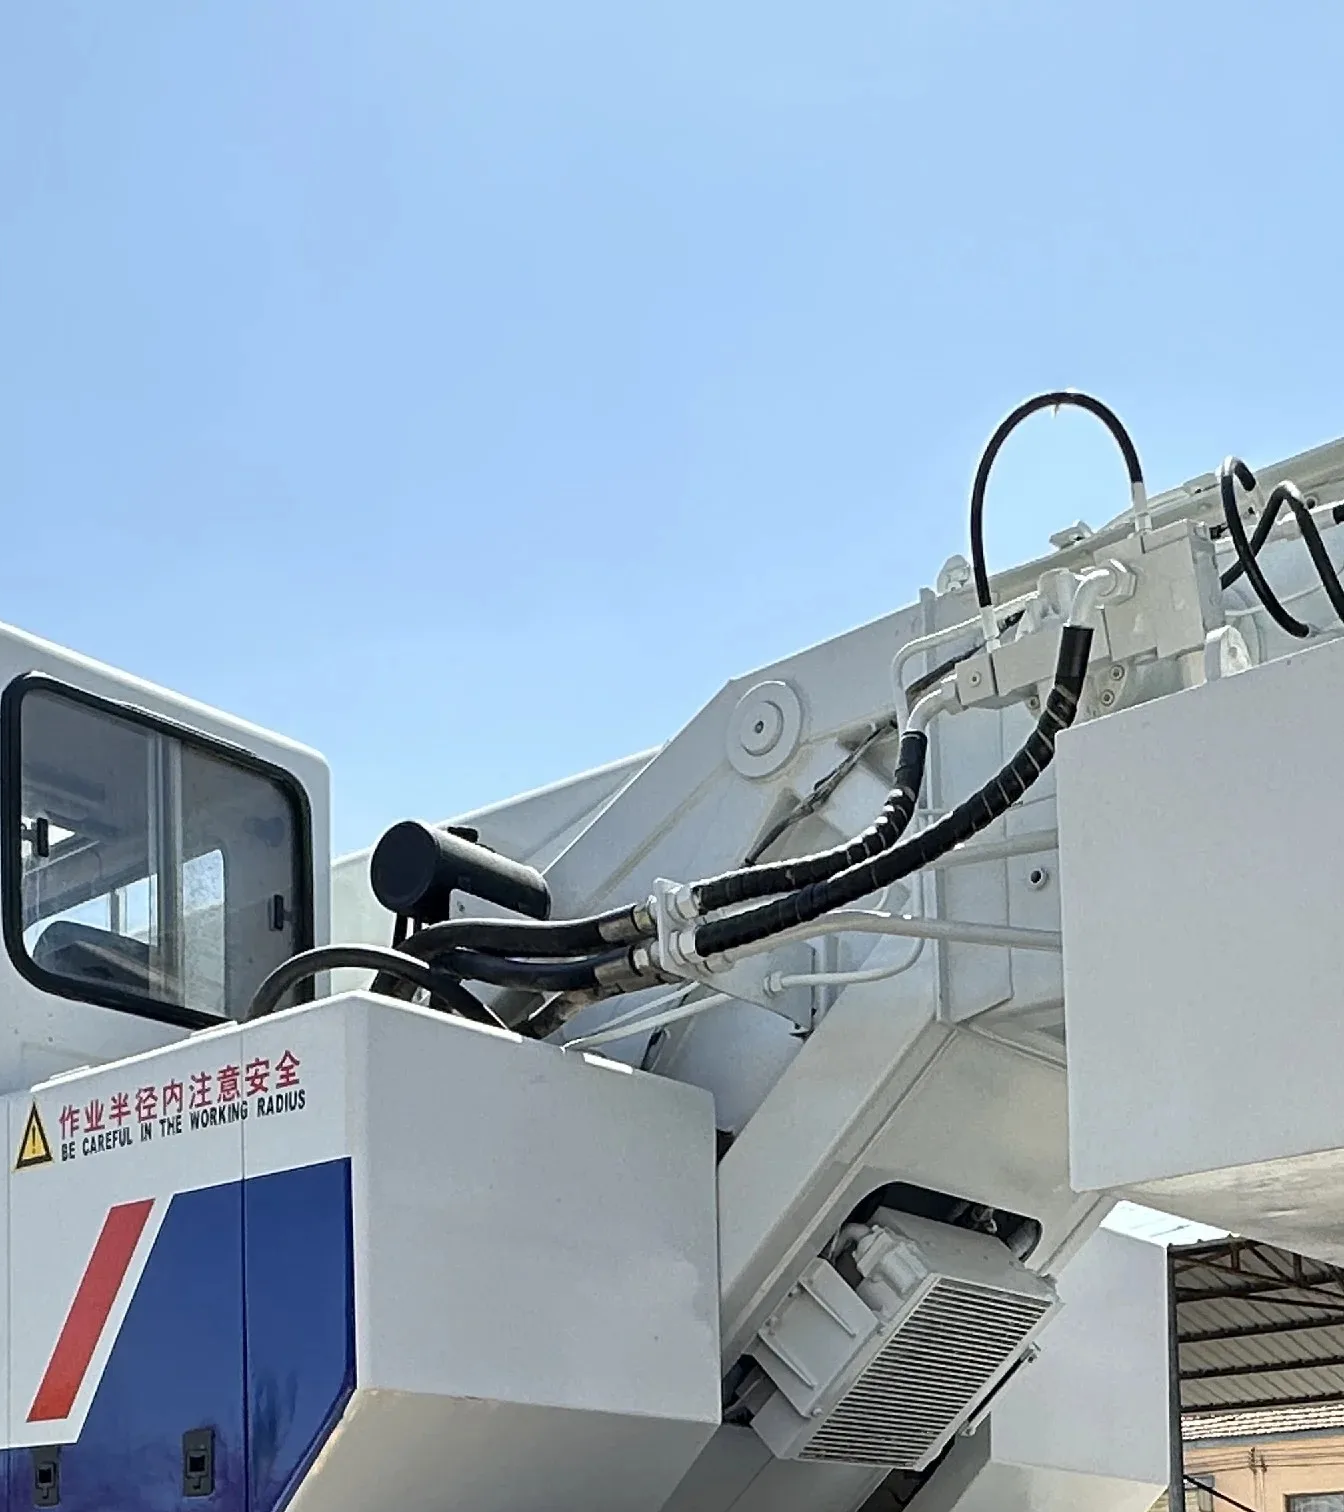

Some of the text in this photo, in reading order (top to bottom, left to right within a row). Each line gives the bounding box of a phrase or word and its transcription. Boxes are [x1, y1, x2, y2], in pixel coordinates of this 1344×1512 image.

[59, 1049, 301, 1140] 作业半径内注意安全
[61, 1089, 306, 1162] BE CAREFUL IN THE WORKING RADIUS
